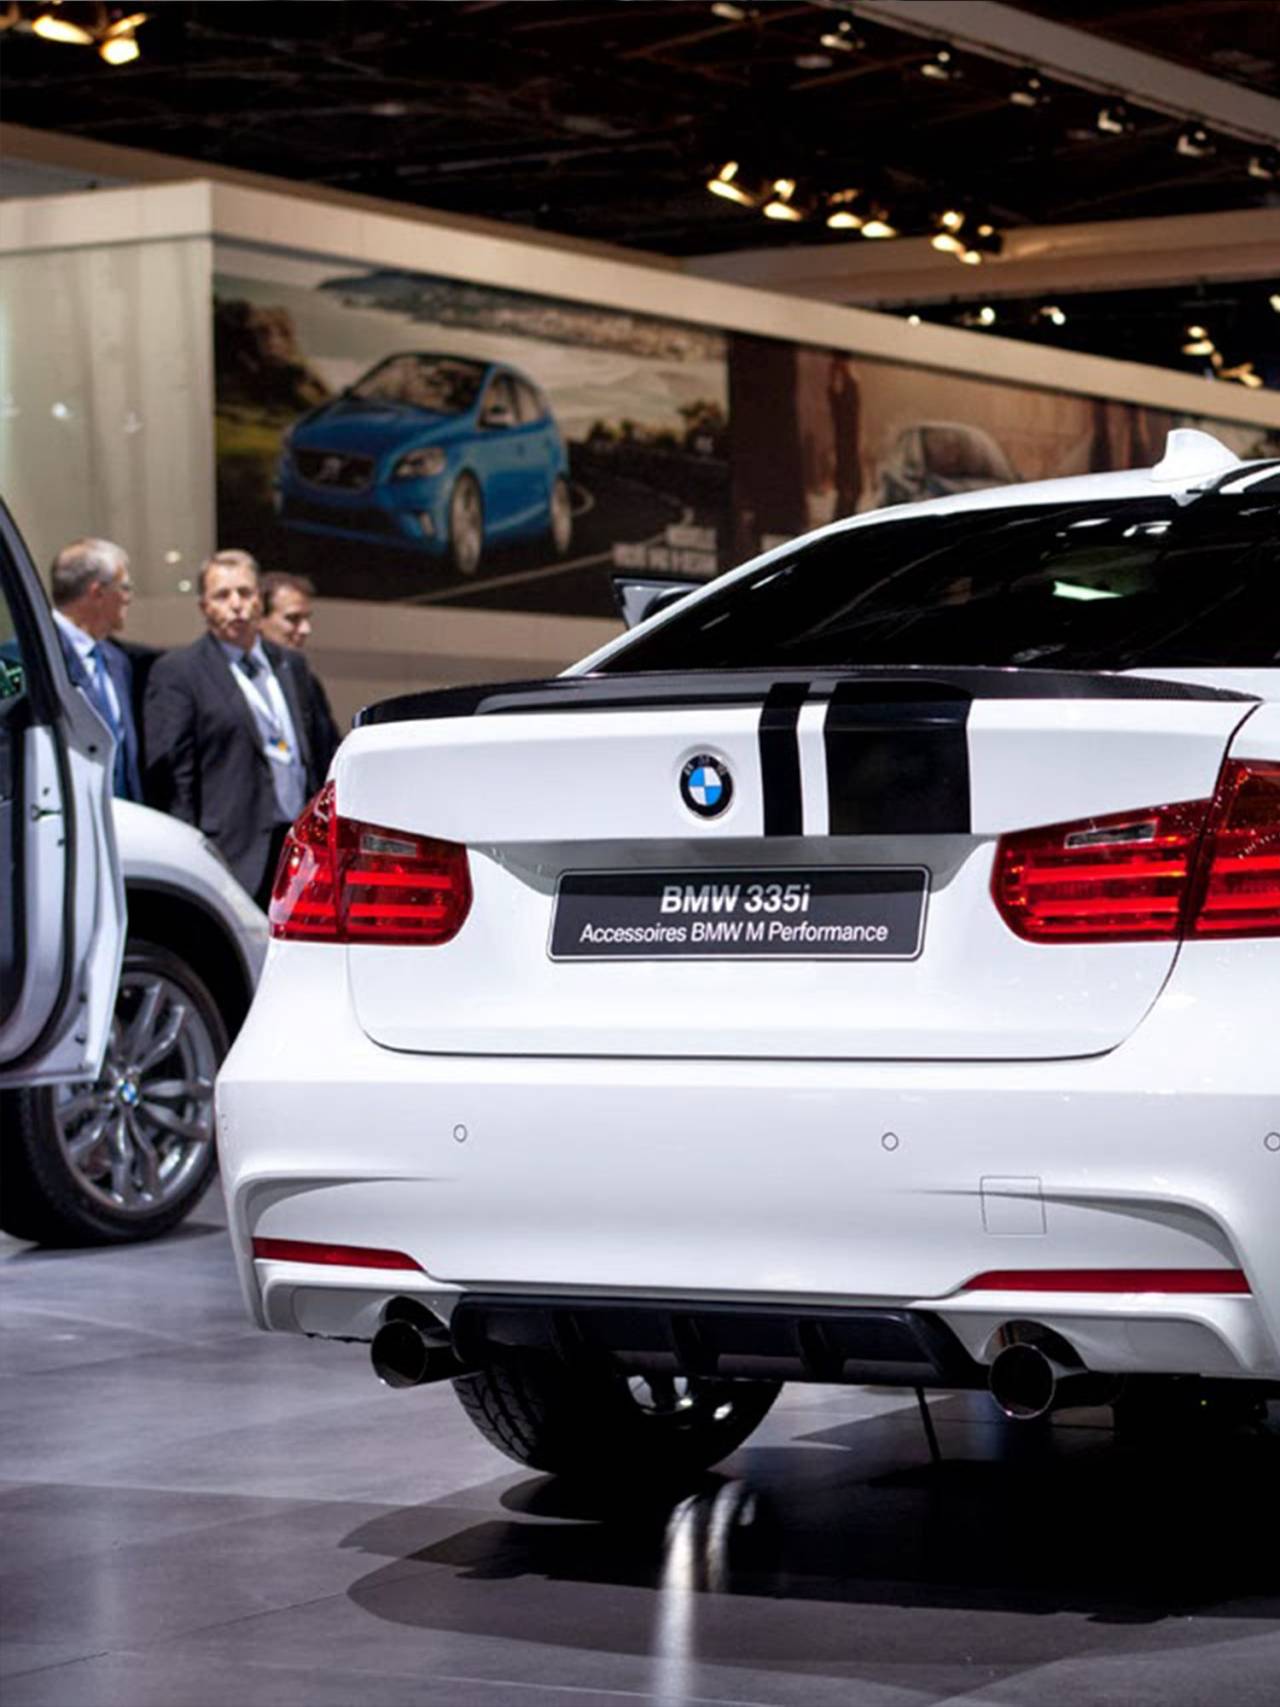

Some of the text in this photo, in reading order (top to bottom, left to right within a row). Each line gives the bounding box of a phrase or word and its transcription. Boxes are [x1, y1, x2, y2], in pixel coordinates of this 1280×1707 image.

[660, 884, 810, 913] BMW 335i
[579, 920, 889, 944] Accessoires BMW M Performance
